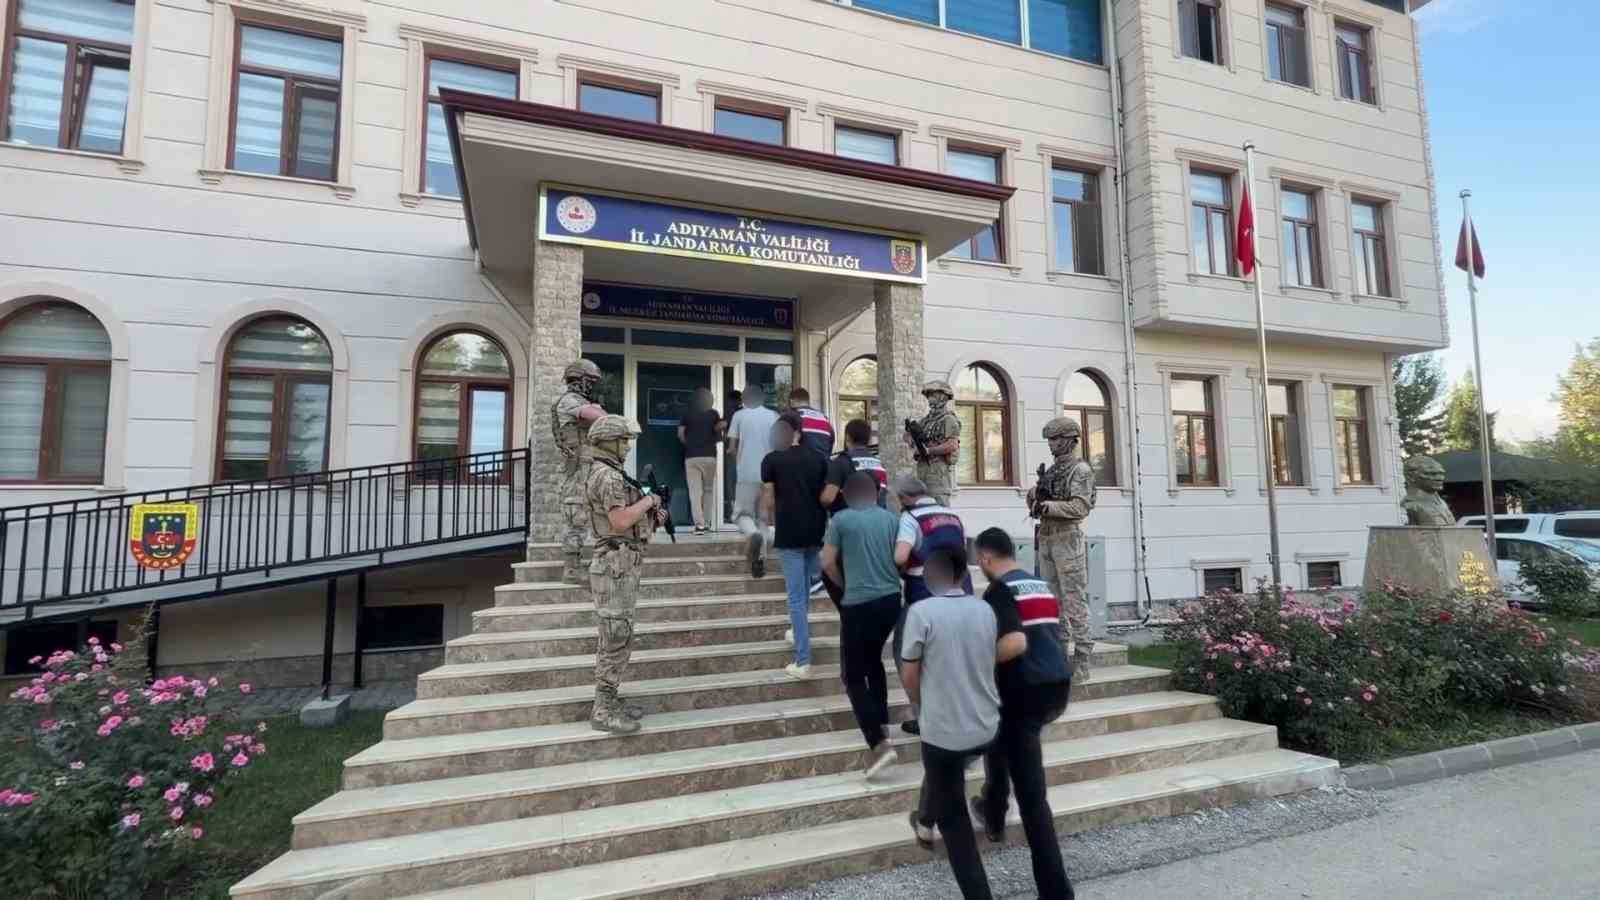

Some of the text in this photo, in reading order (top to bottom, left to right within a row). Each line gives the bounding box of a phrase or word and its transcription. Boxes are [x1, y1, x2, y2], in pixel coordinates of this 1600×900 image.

[667, 221, 831, 253] ADIYAMAN VALİLİĞİ
[736, 217, 766, 232] T.C.
[630, 227, 861, 270] İL JANDARMA KOMUTANLIĞI
